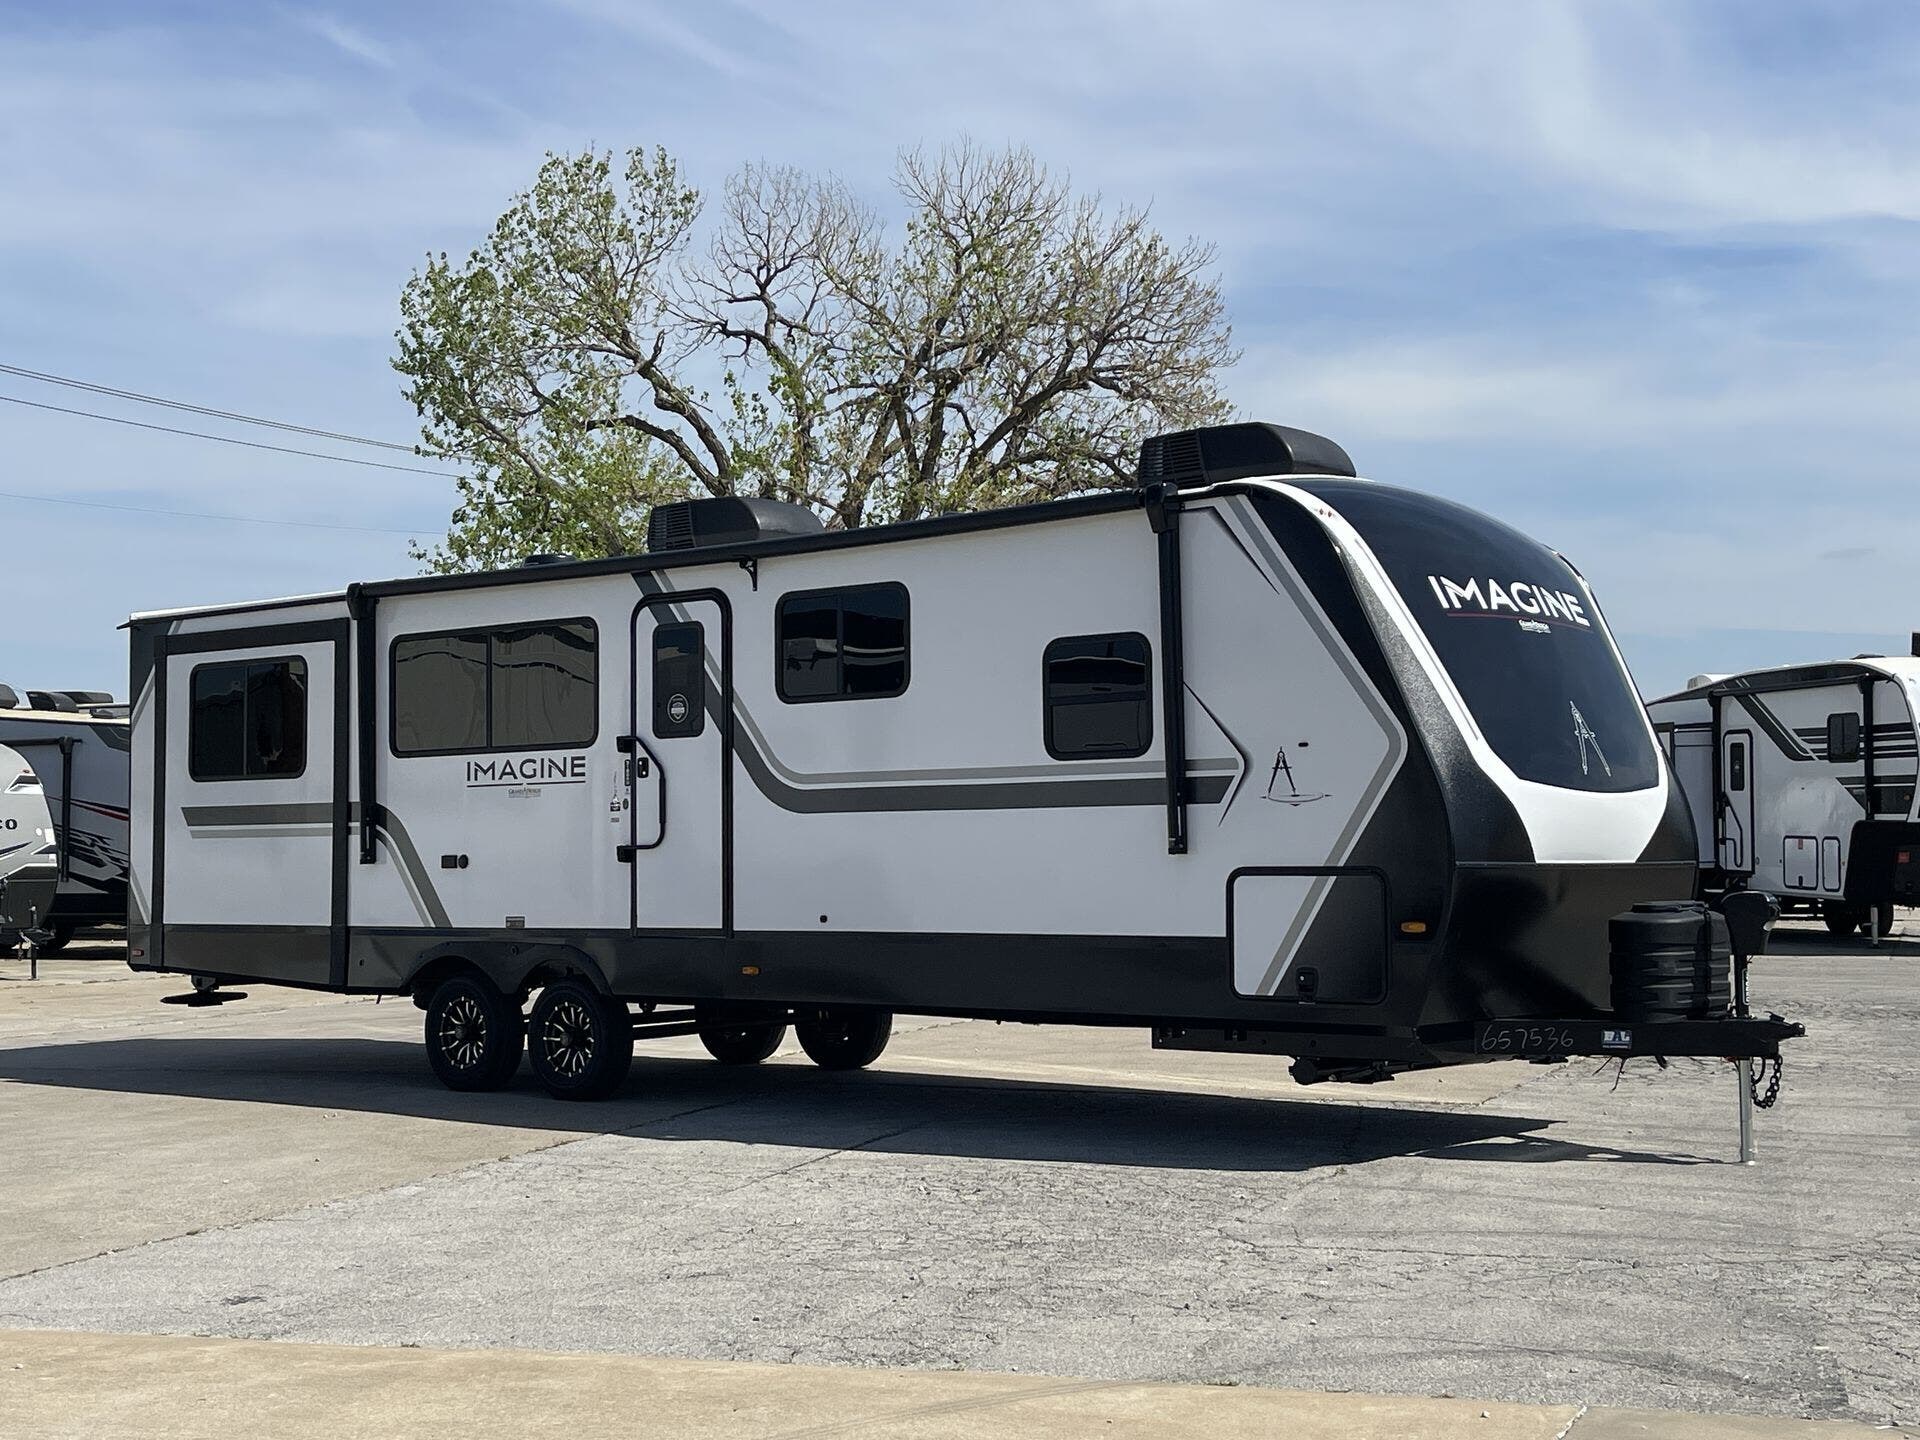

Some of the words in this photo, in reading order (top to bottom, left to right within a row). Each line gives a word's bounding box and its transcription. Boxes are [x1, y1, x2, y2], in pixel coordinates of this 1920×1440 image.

[1427, 575, 1591, 627] IMAGINE
[466, 756, 586, 782] IMAGINE
[1481, 1024, 1574, 1051] 657536
